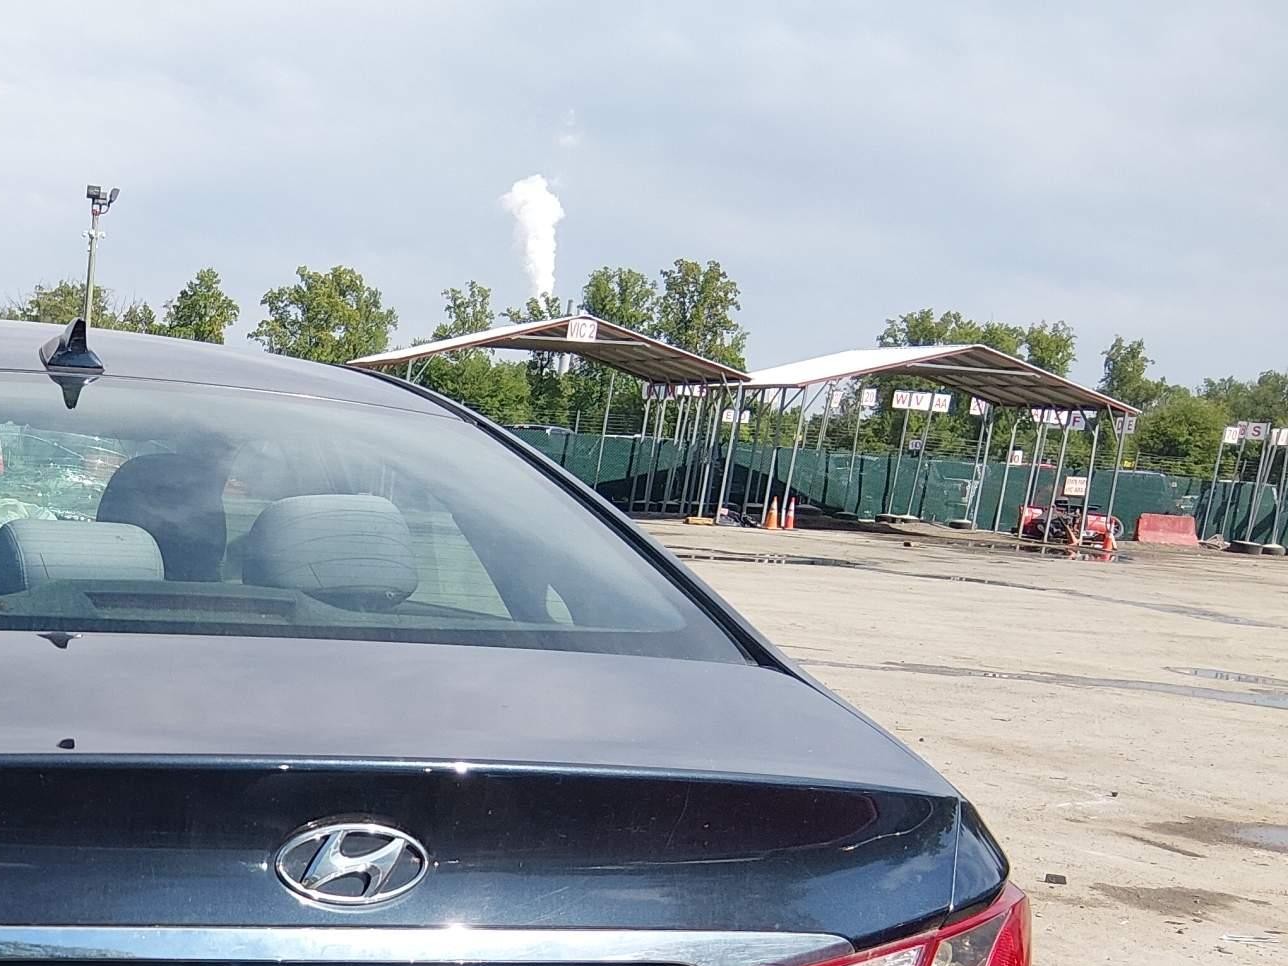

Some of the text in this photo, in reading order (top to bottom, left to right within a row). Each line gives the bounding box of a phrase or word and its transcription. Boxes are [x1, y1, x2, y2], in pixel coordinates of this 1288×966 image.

[570, 321, 596, 338] VIC 2
[896, 394, 907, 405] W
[915, 395, 924, 406] V
[934, 399, 947, 410] AA
[1072, 416, 1081, 428] F
[1127, 419, 1134, 431] E
[1252, 425, 1262, 437] S
